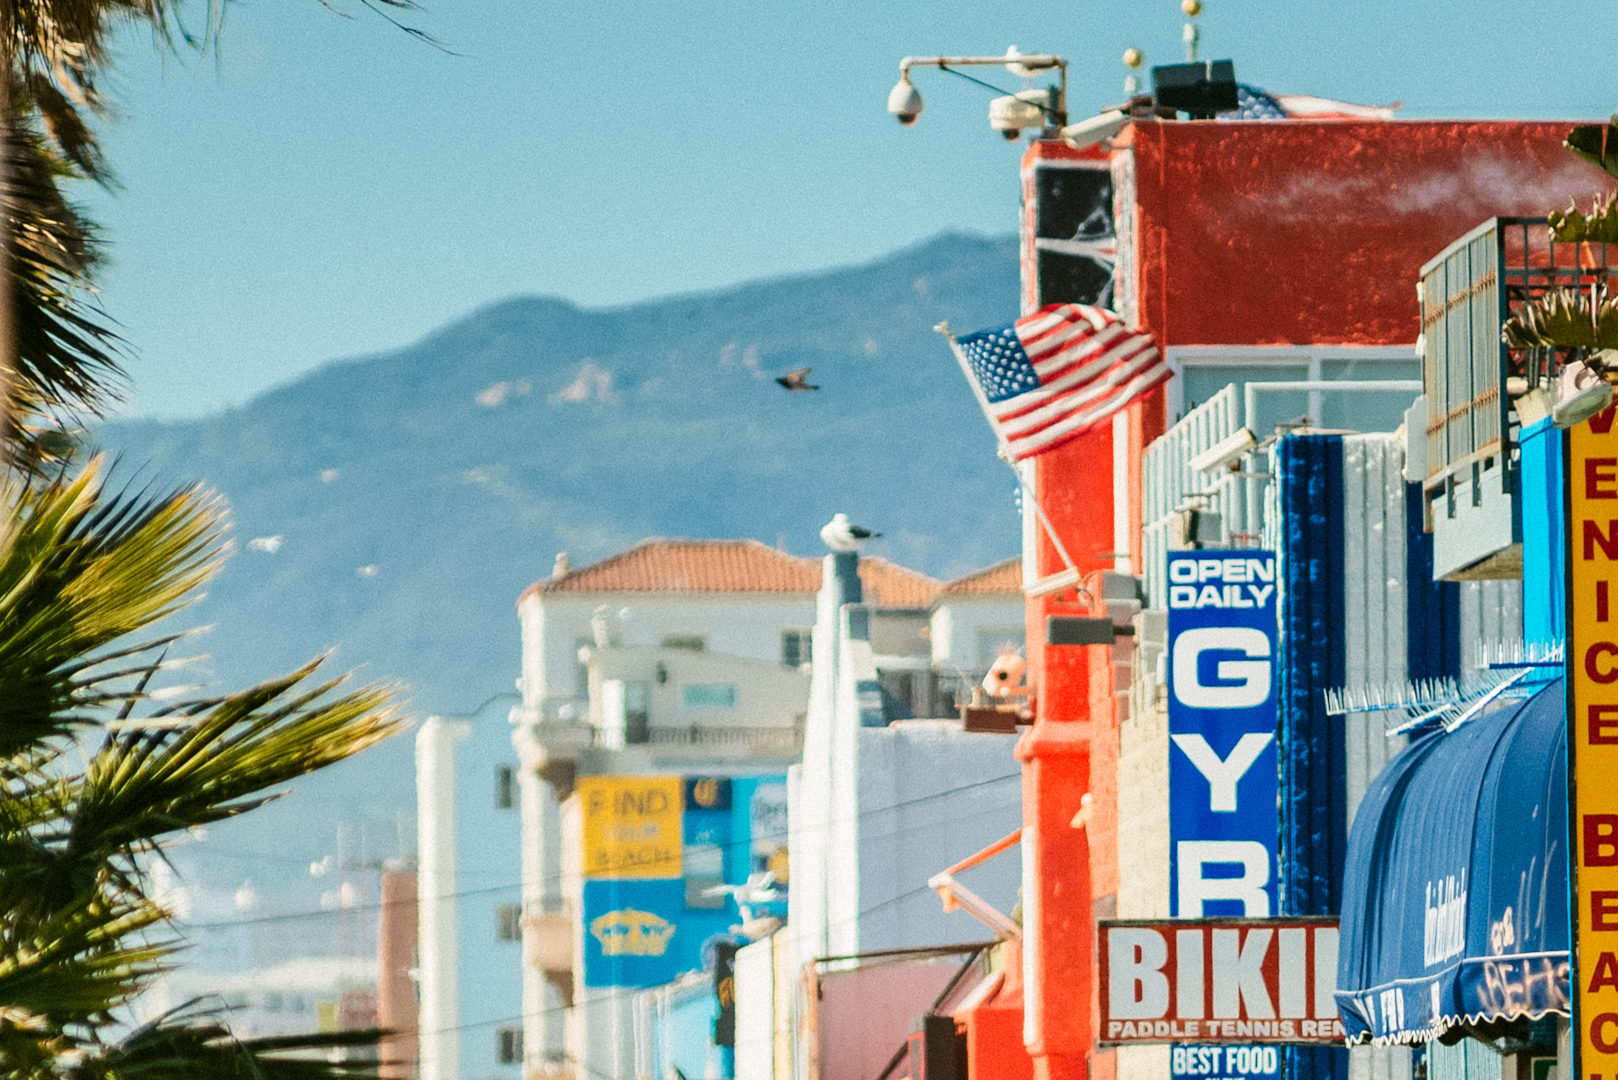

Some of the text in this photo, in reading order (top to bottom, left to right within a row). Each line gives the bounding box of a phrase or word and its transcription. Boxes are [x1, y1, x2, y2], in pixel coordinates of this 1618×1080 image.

[1170, 558, 1274, 584] OPEN
[1170, 585, 1275, 609] DAILY
[1107, 1020, 1199, 1038] PADDLE
[1206, 1019, 1295, 1038] TENNIS
[1173, 1046, 1278, 1075] BEST FOOD
